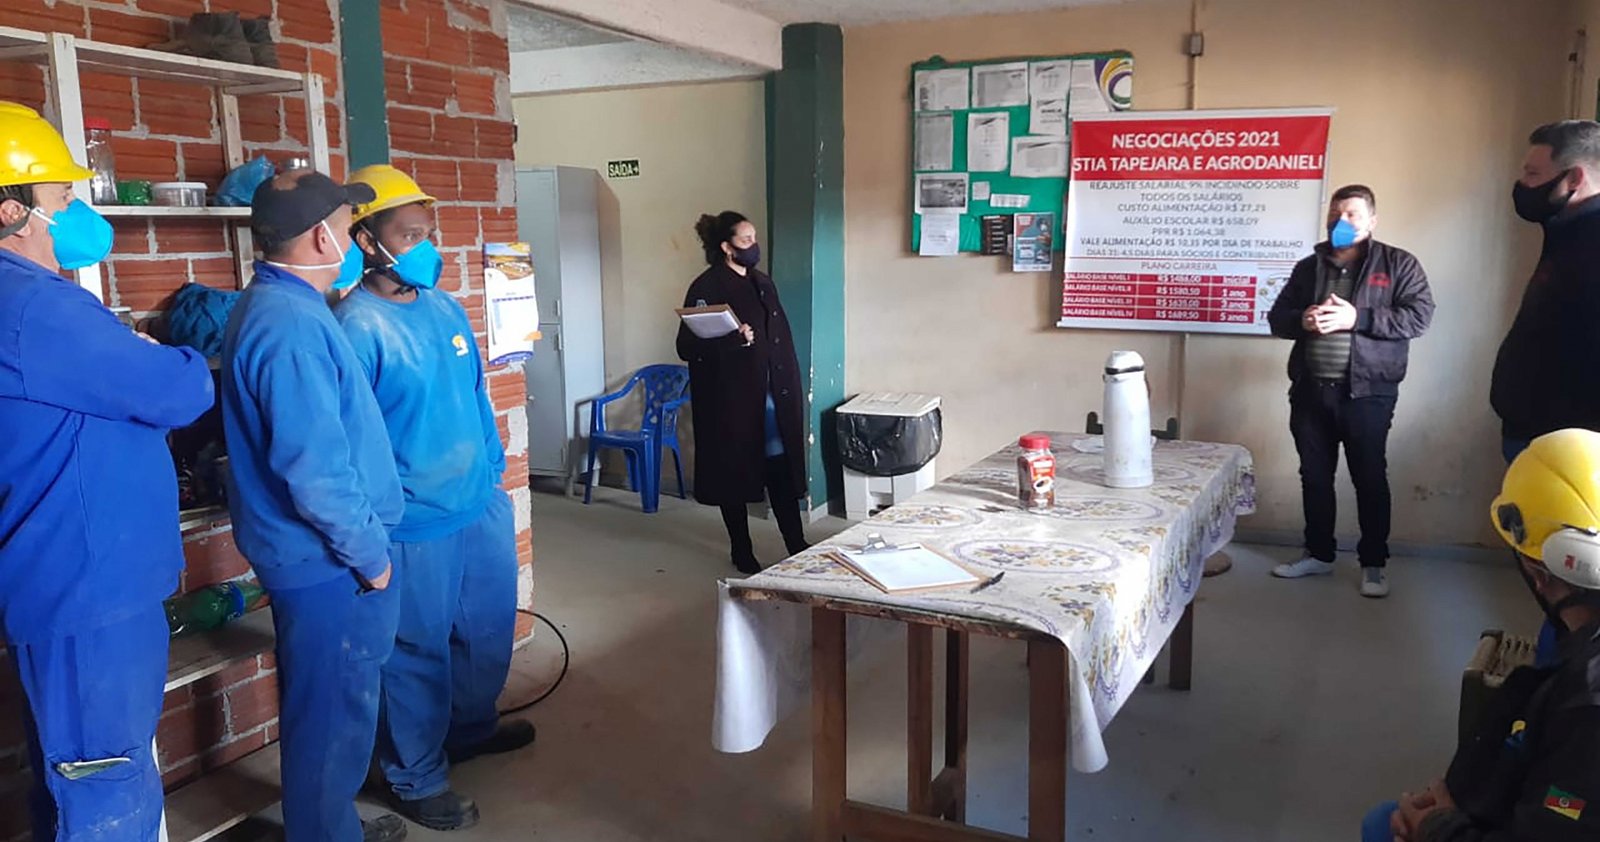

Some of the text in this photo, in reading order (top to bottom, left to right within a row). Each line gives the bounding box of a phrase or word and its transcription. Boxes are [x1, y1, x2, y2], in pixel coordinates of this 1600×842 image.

[1112, 129, 1280, 150] NEGOCIAÇÕES 2021
[1072, 154, 1323, 171] STIA TAPEJARA E AGRODANIELI
[1089, 181, 1136, 190] REAJUSTE
[1138, 181, 1186, 189] SALARIAL
[1203, 181, 1263, 189] INCIDINDO
[1265, 181, 1300, 190] SOBRE
[1140, 191, 1243, 202] TODOS OS SALÁRIOS
[1117, 203, 1149, 212] CUSTO
[1151, 202, 1223, 213] ALIMENTAÇÃO
[1225, 203, 1238, 212] R$
[1122, 215, 1162, 225] AUXÍLIO
[1164, 216, 1210, 225] ESCOLAR
[1212, 217, 1224, 226] R$
[1152, 227, 1170, 236] PPR
[1172, 227, 1185, 236] R$
[1080, 237, 1100, 246] VALE
[1101, 236, 1163, 247] ALIMENTAÇÃO
[1164, 238, 1176, 247] R$
[1202, 239, 1220, 247] POR
[1222, 239, 1238, 248] DIA
[1240, 240, 1253, 248] DE
[1254, 240, 1304, 249] TRABALHO
[1141, 261, 1218, 271] PLANO CARREIRA
[1156, 286, 1167, 295] R$
[1155, 310, 1167, 319] R$
